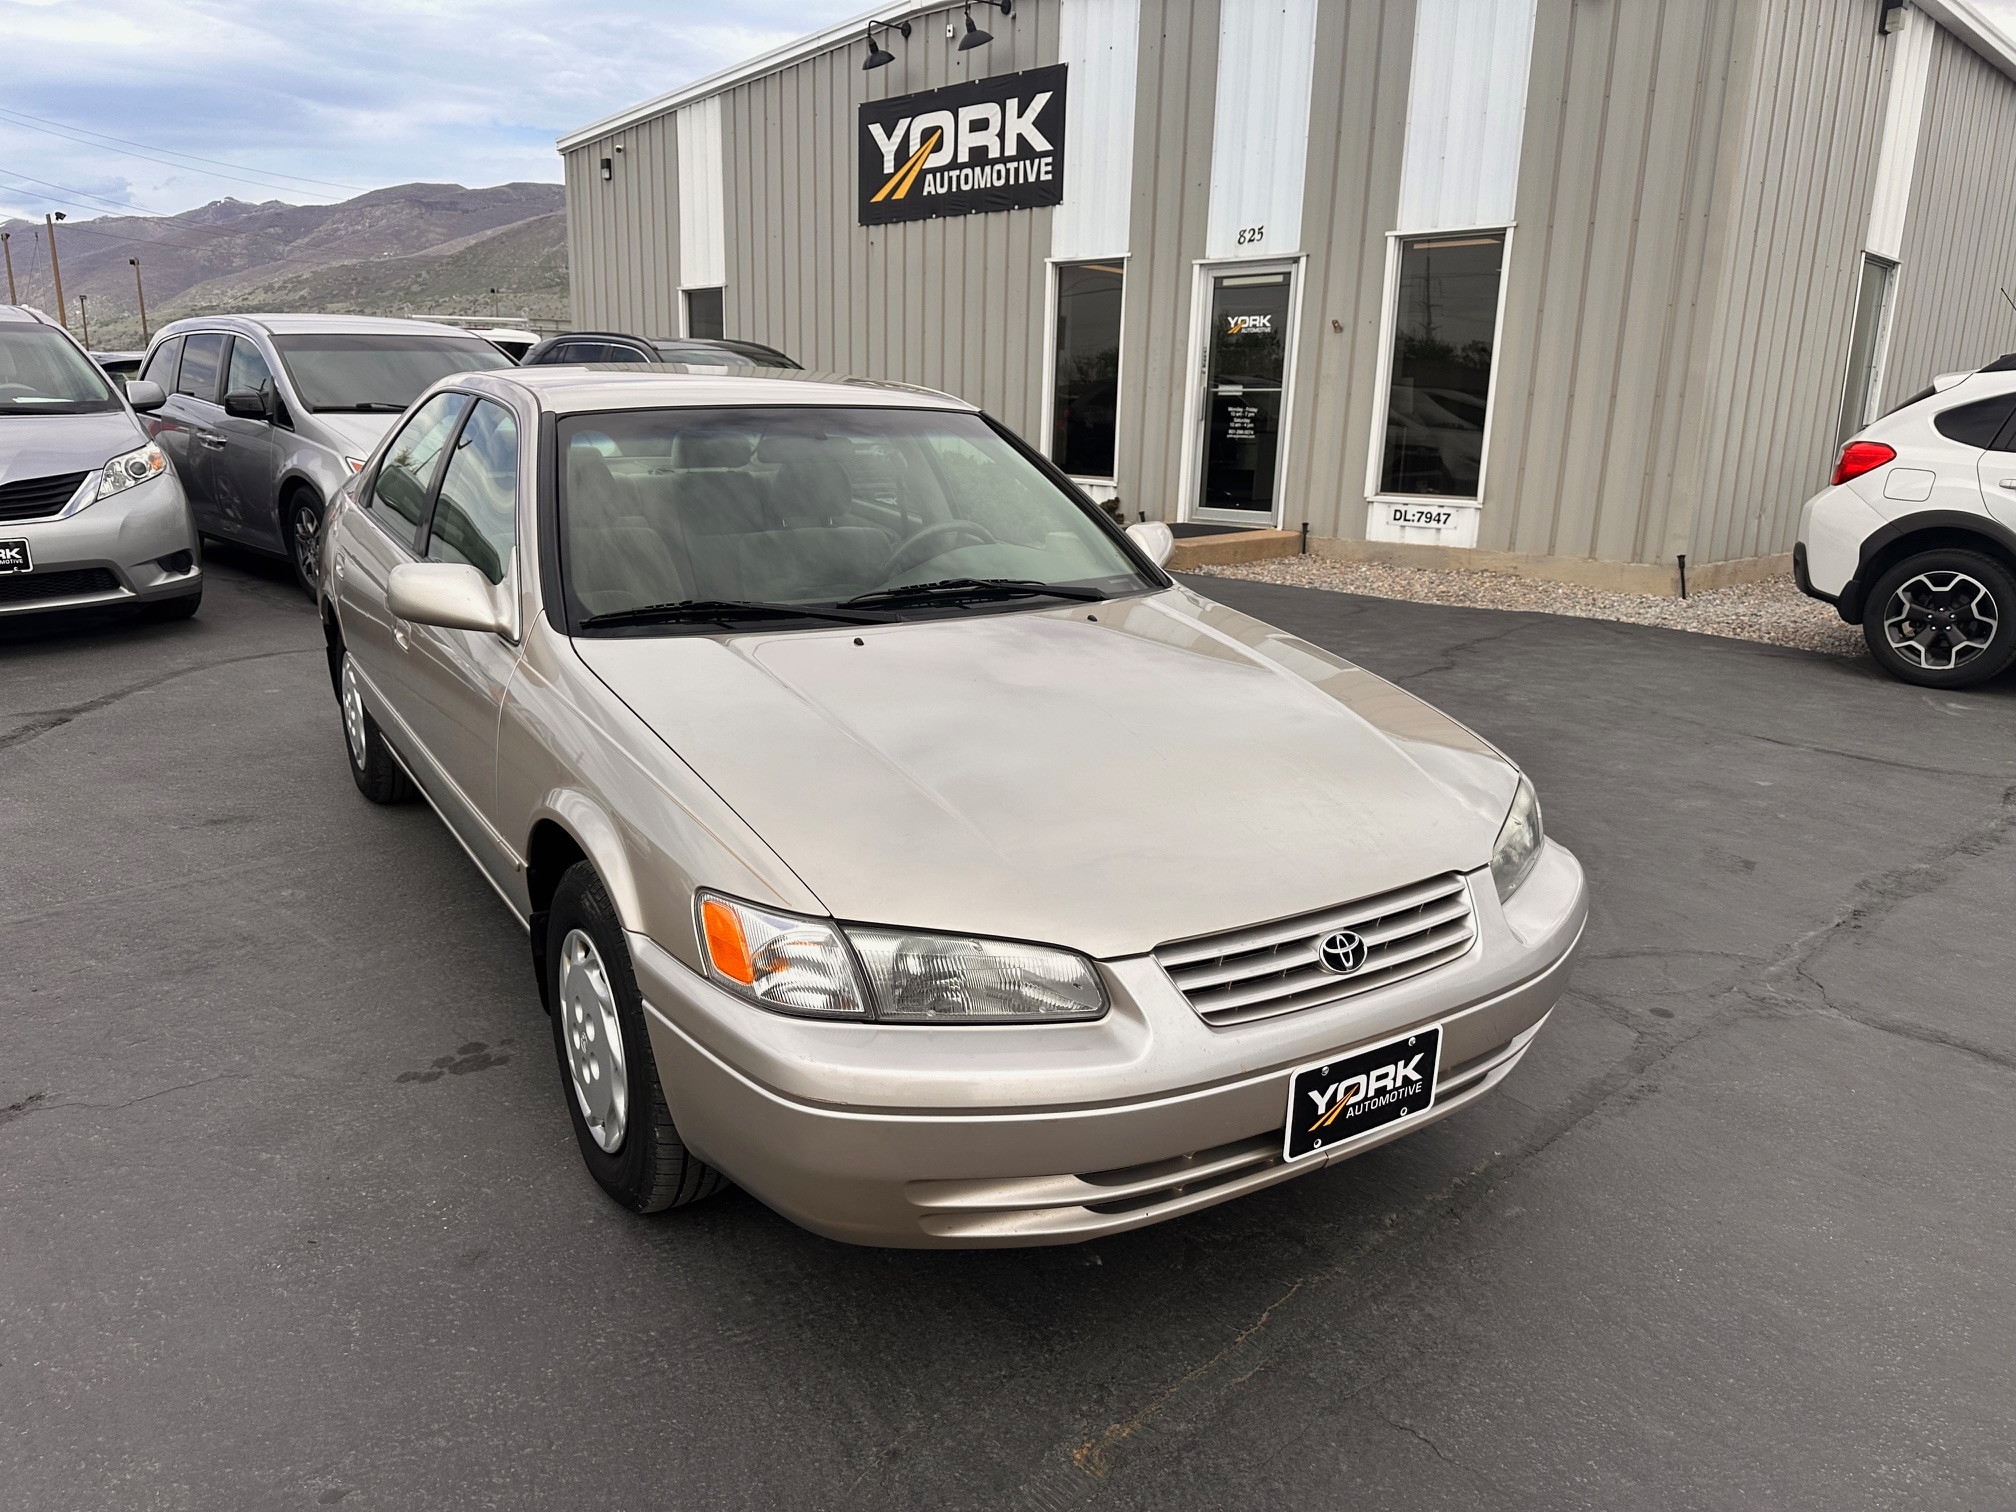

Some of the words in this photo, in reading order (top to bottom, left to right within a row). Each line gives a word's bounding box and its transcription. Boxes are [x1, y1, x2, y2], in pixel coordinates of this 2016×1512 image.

[867, 91, 1054, 174] YORK
[922, 156, 1053, 196] AUTOMOTIVE
[1237, 225, 1264, 245] 825
[1227, 314, 1272, 328] YORK
[1393, 509, 1451, 525] DL:7947
[1307, 1052, 1425, 1115] YORK
[1346, 1081, 1423, 1119] AUTOMOTIVE
